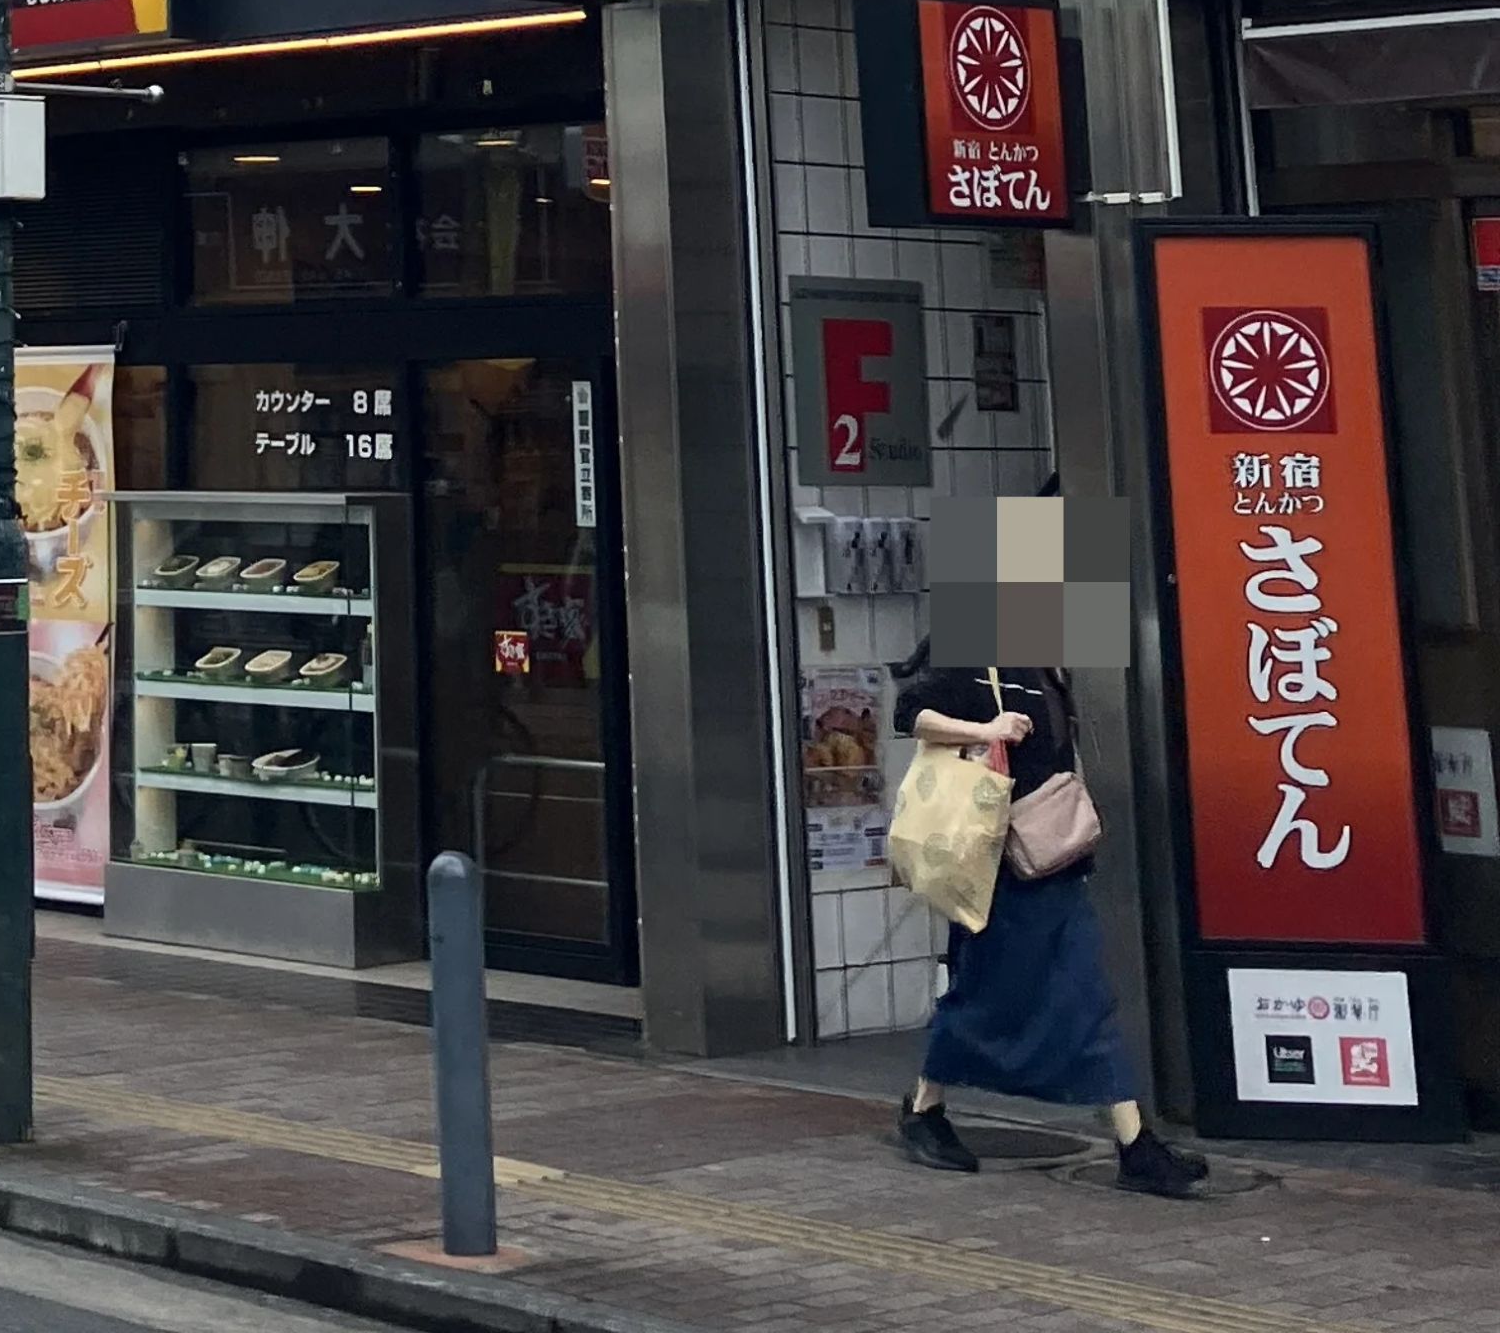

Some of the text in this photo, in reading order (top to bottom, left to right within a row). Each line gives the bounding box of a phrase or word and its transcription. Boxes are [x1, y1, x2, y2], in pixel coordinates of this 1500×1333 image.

[953, 139, 1039, 163] 新宿 とんかつ
[947, 164, 1051, 212] さぼてん
[255, 389, 332, 414] カウンター
[255, 431, 316, 456] テーブル
[832, 414, 862, 466] 2
[1231, 452, 1321, 490] 新宿
[1232, 493, 1325, 516] とんかつ
[55, 469, 94, 614] チーズ
[1239, 525, 1351, 869] さぼてん
